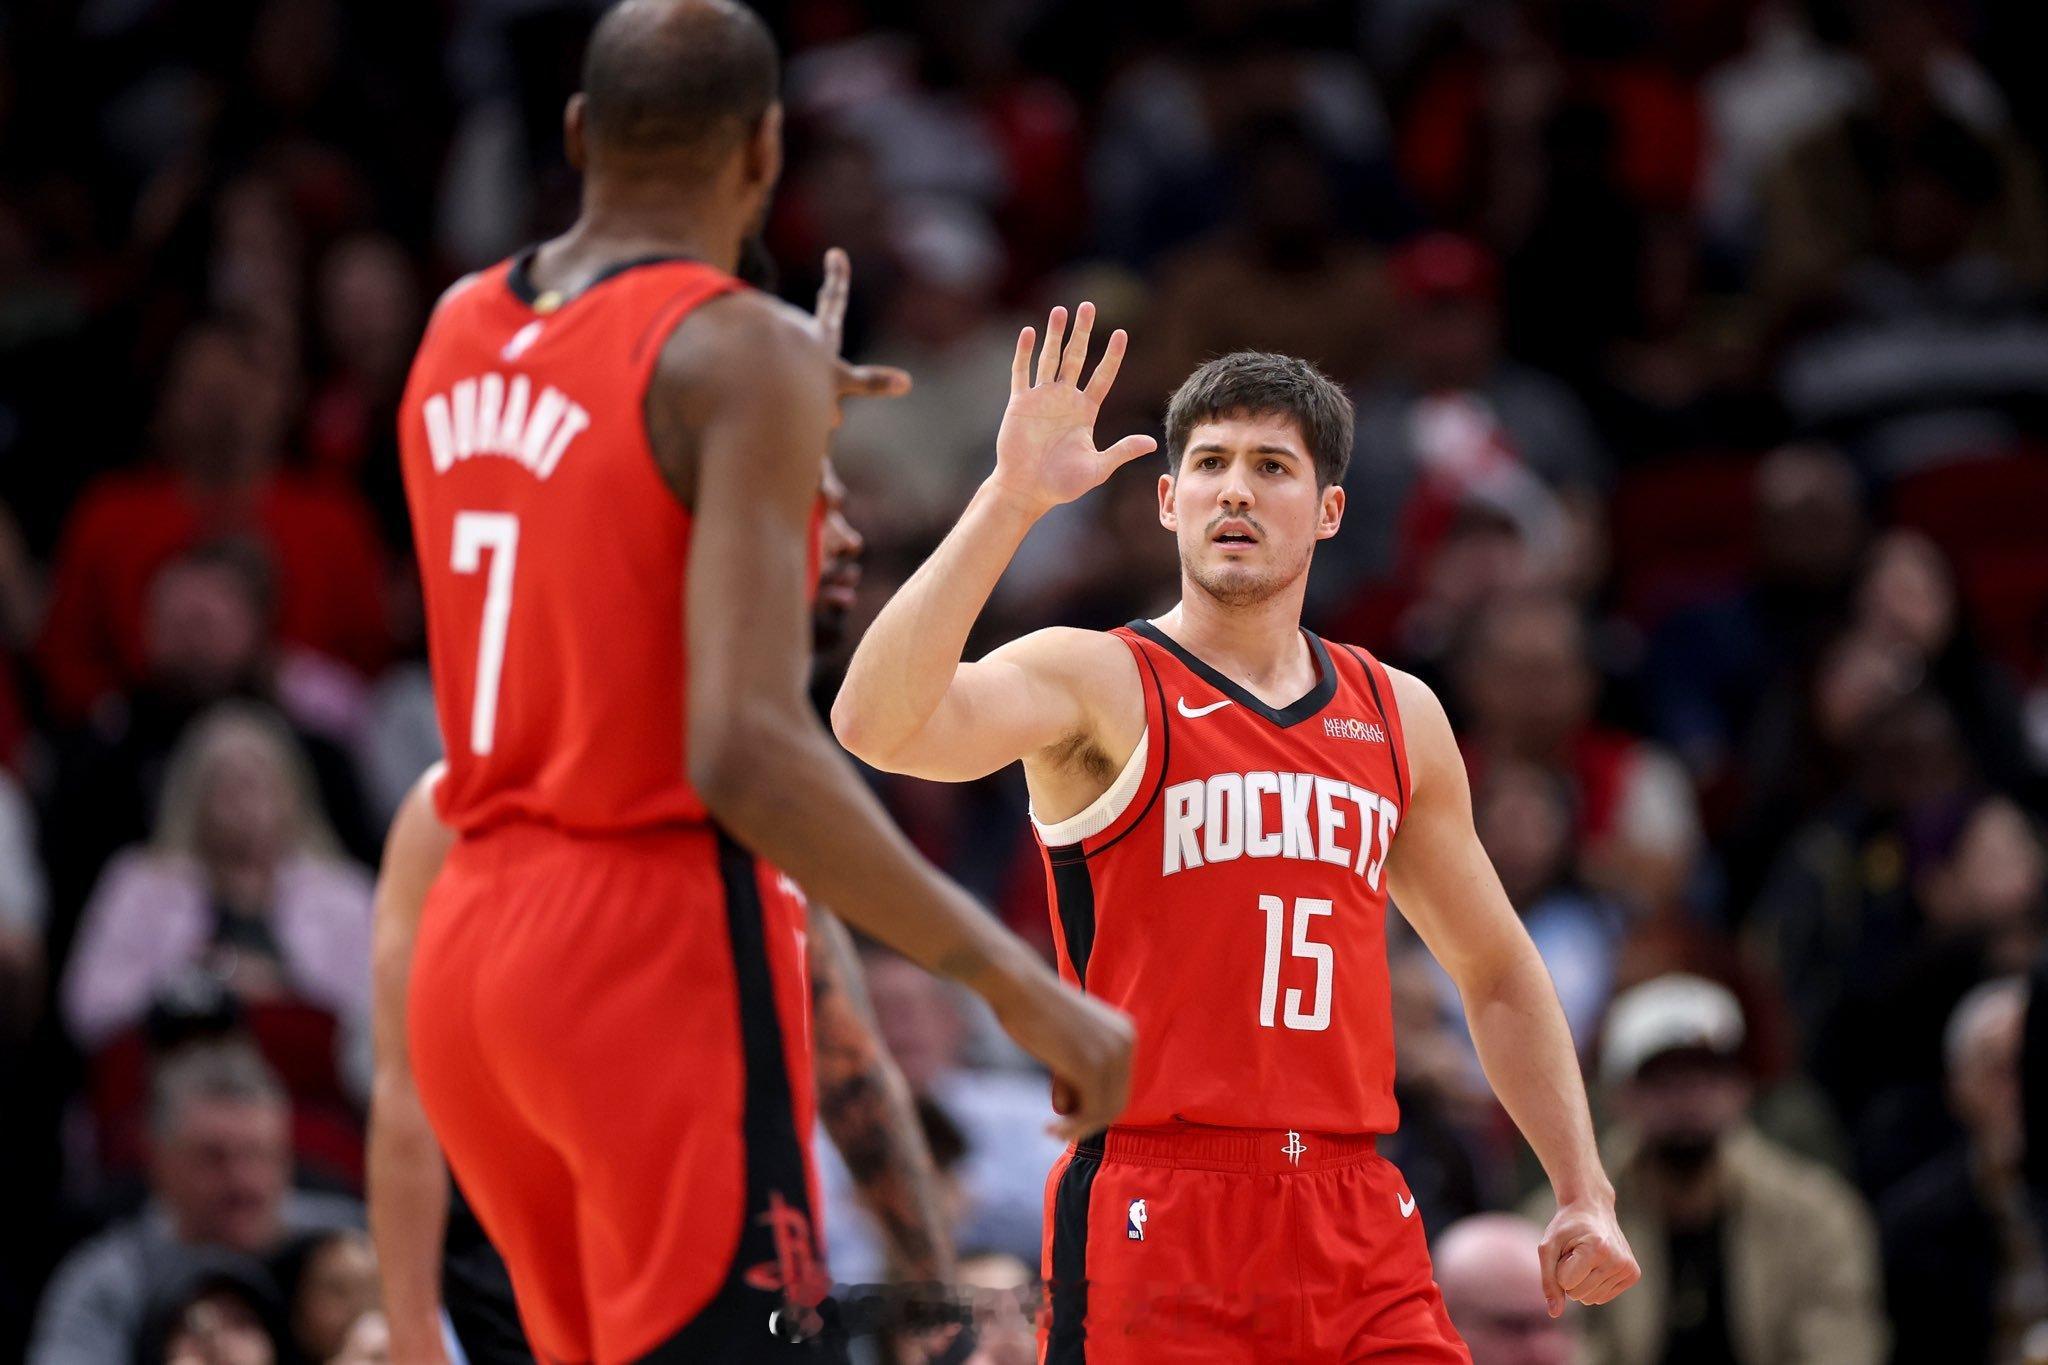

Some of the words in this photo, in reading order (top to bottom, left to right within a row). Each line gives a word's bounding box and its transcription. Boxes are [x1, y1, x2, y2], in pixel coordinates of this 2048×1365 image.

[450, 511, 519, 756] 7
[1323, 717, 1383, 733] MEMORIAL
[1325, 726, 1385, 742] HERMANN
[1162, 771, 1399, 893] ROCKETS
[1258, 894, 1334, 1031] 15
